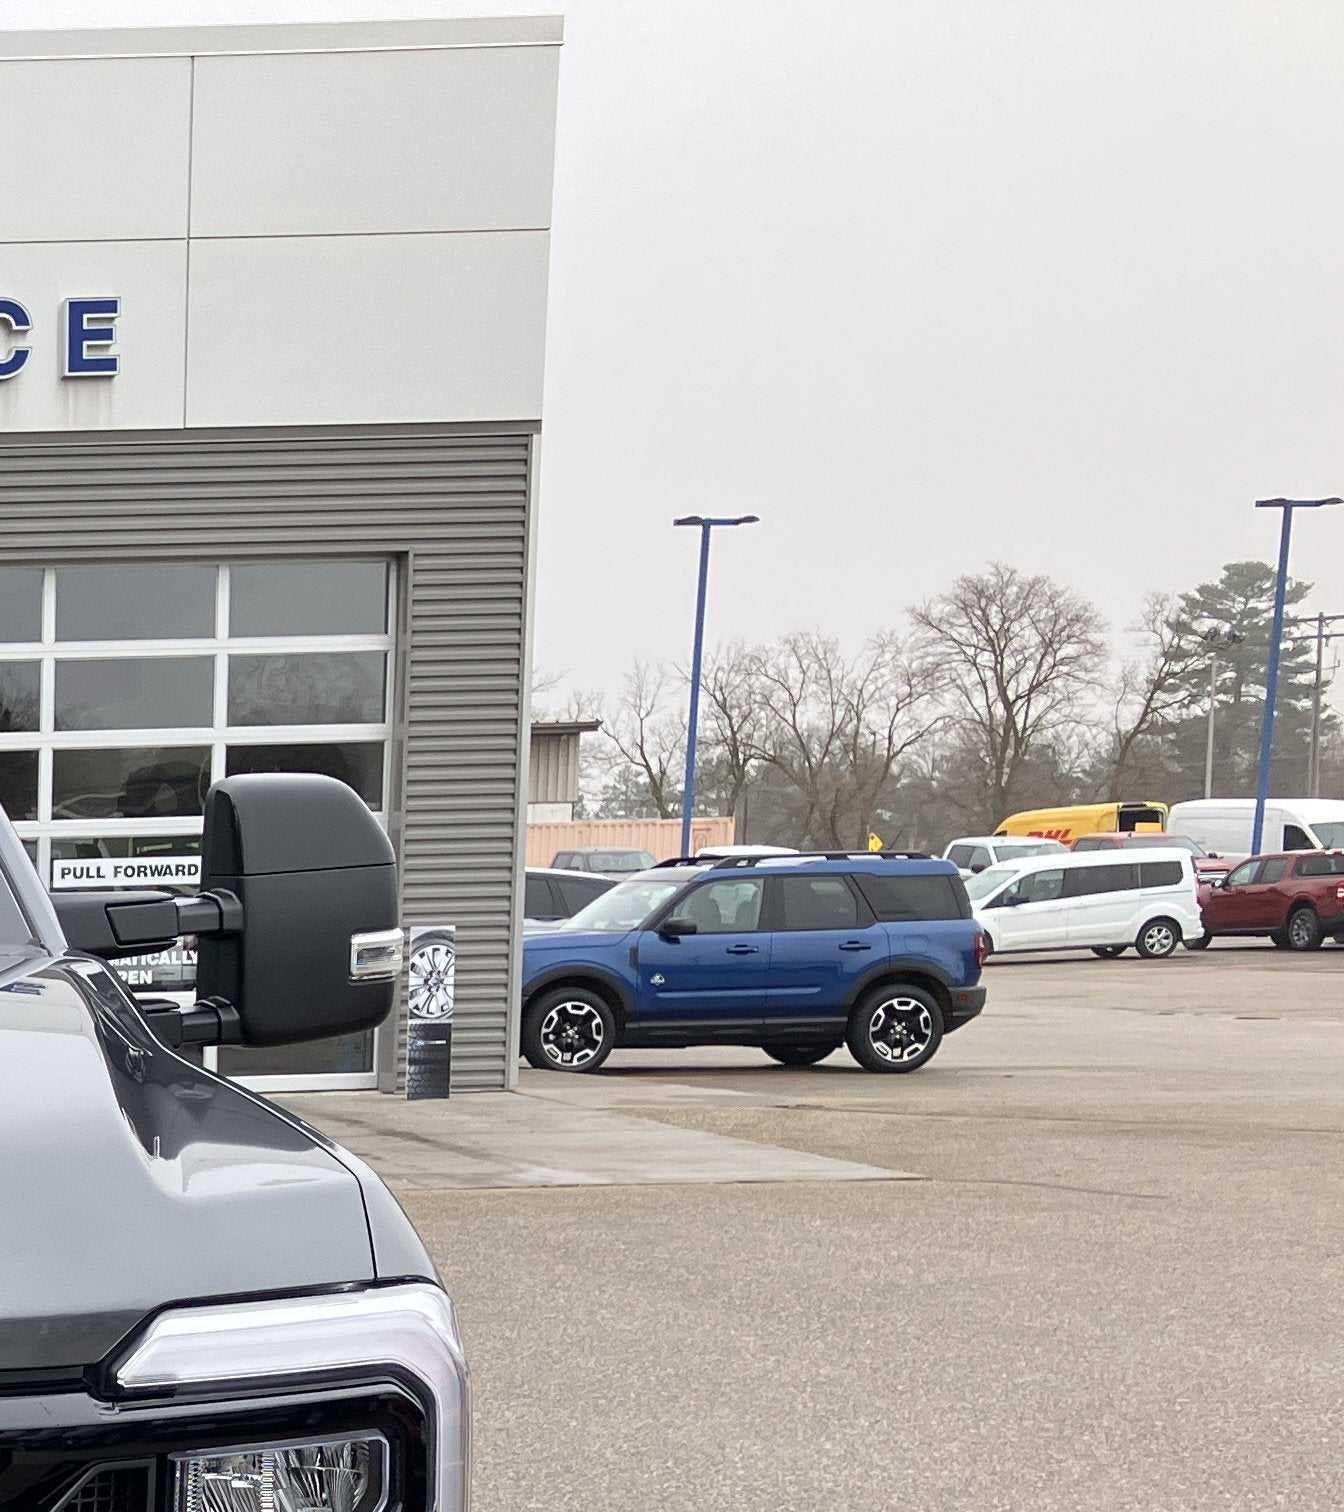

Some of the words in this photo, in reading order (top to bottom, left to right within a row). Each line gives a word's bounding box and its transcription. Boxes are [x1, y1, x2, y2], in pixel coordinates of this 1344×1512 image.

[60, 865, 106, 880] PULL
[113, 863, 199, 879] FORWARD
[108, 950, 198, 966] ATICALLY
[117, 969, 153, 985] PEN
